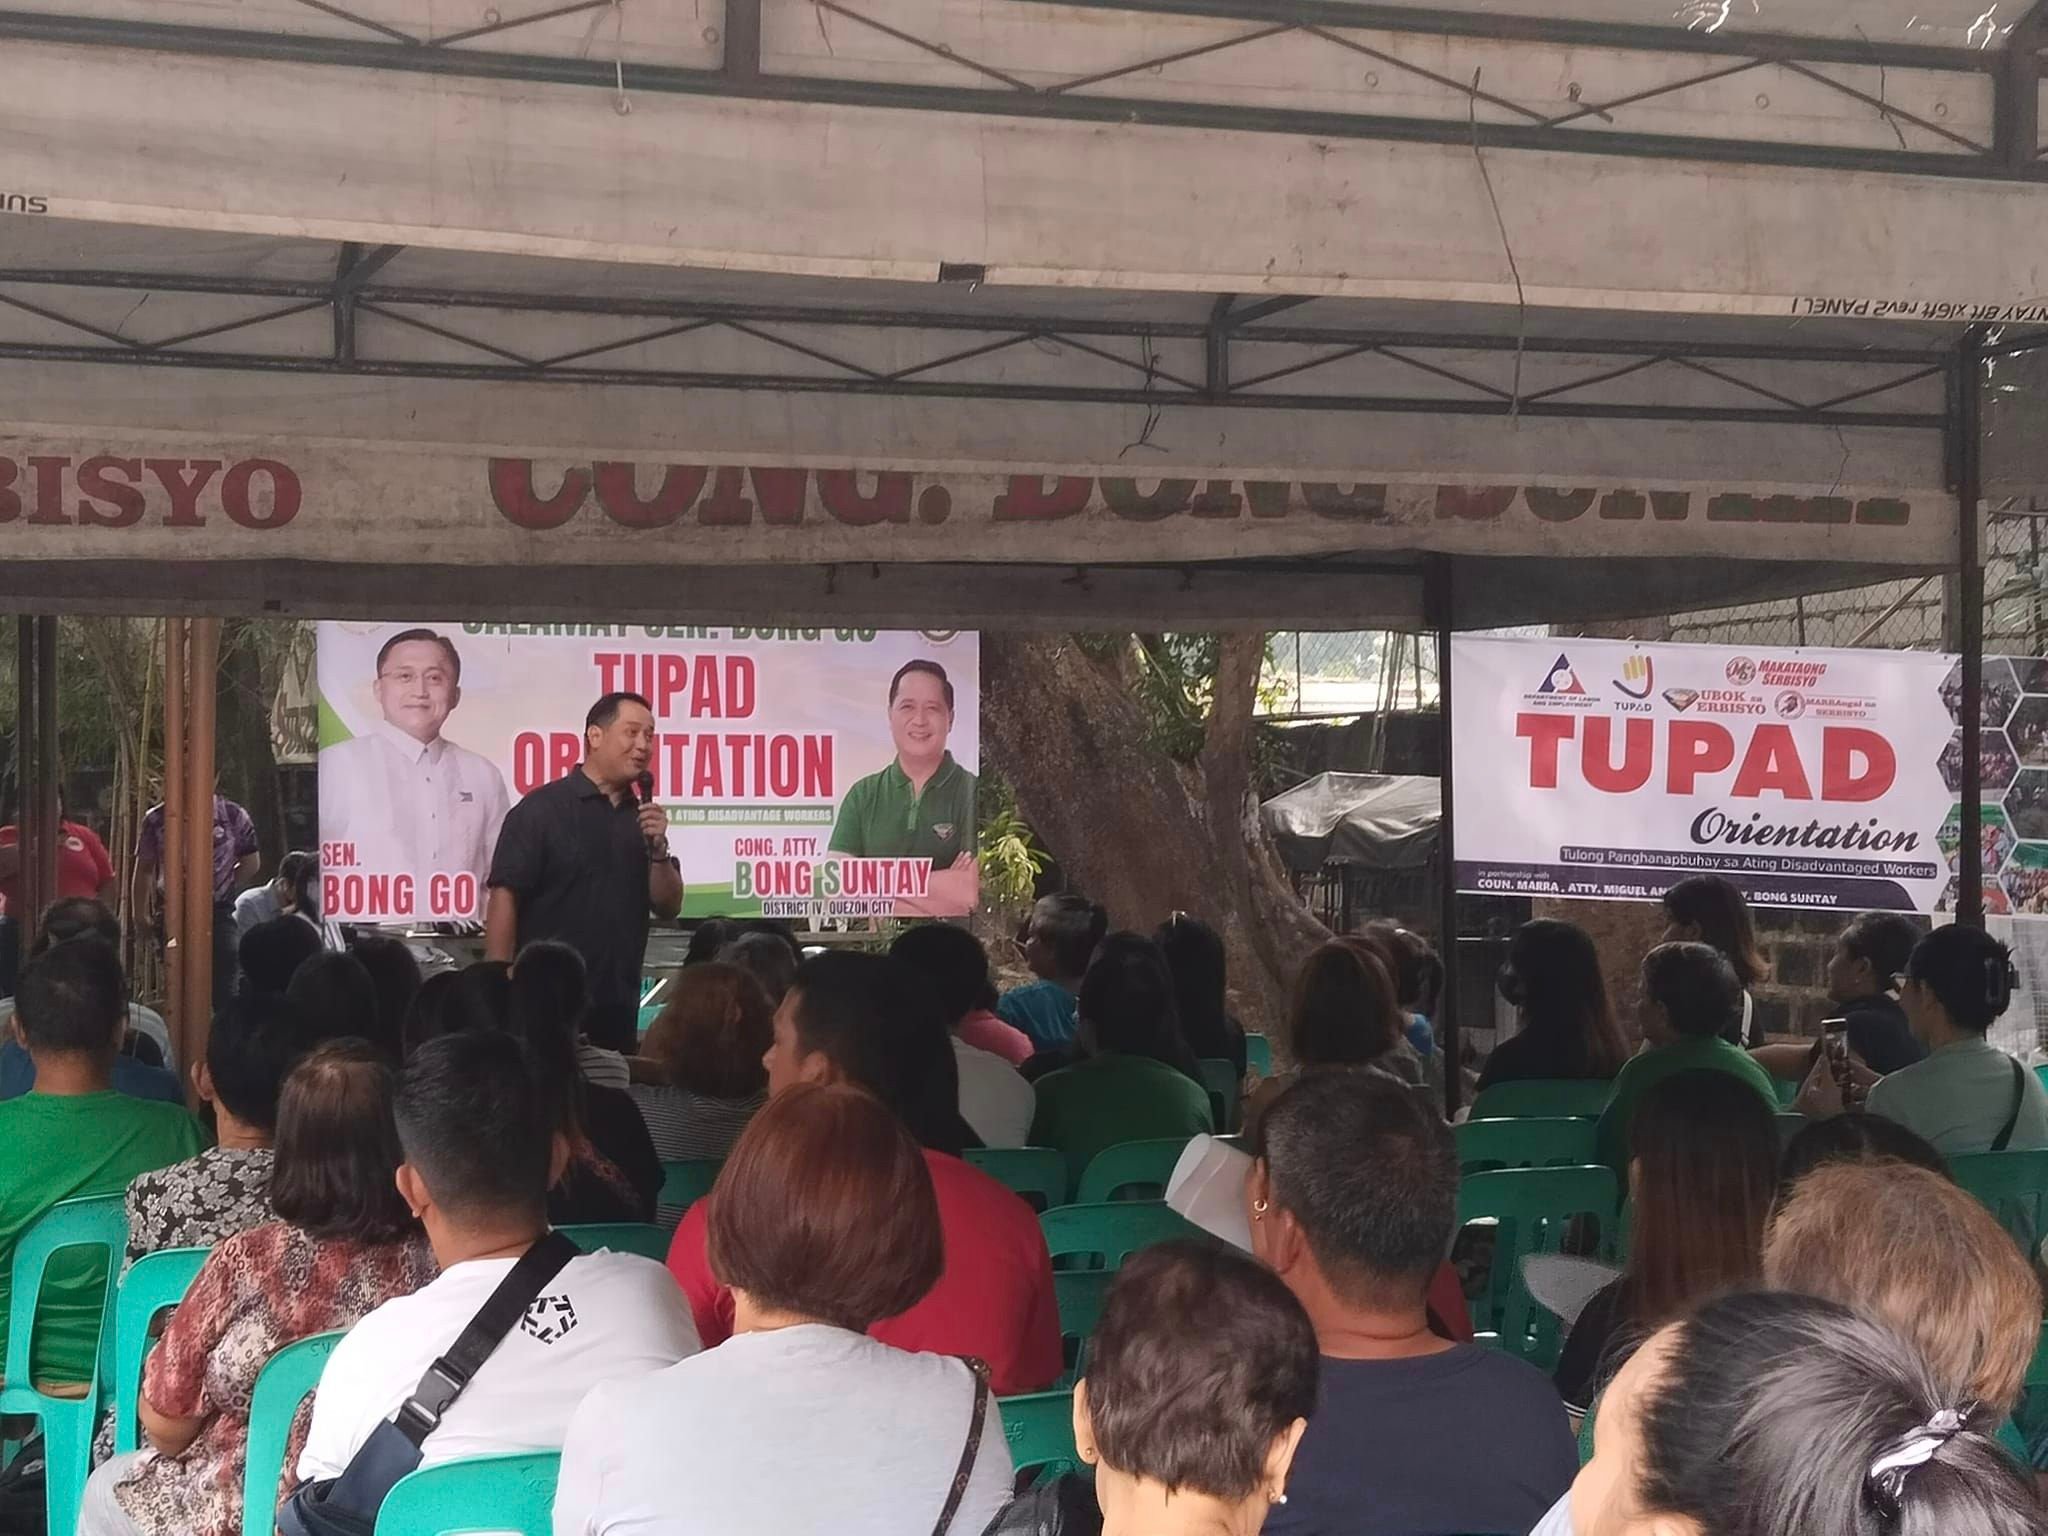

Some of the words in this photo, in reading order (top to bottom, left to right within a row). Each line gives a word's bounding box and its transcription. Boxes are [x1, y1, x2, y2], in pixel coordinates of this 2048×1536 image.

[1804, 298, 1869, 317] PANEL
[1873, 300, 1919, 317] rev2
[1758, 660, 1827, 676] MAKATAONG
[594, 653, 756, 718] TUPAD
[1761, 673, 1818, 688] SERBISYO
[1614, 702, 1653, 712] TUPAD
[513, 731, 834, 798] ORTATION
[1516, 713, 1897, 802] TUPAD
[1690, 806, 1920, 853] Orientation
[322, 843, 362, 867] SEN.
[735, 838, 778, 857] CONG.
[783, 838, 822, 857] ATTY.
[1563, 848, 1604, 863] Tulong
[1608, 850, 1720, 868] Panghanapbuhay
[1723, 858, 1738, 868] sa
[1742, 858, 1777, 872] Ating
[1781, 859, 1880, 876] Disadvantaged
[1883, 863, 1936, 877] Workers
[736, 861, 811, 896] BONG
[823, 859, 931, 896] SUNTAY
[323, 874, 415, 916] BONG
[430, 874, 475, 917] GO
[1478, 879, 1515, 890] COUN.
[1568, 883, 1601, 894] ATTY.
[1603, 885, 1647, 896] MIGUEL
[1650, 887, 1669, 897] AN
[763, 901, 809, 915] DISTRICT
[829, 902, 868, 915] QUEZON
[872, 902, 894, 915] CITY
[1753, 892, 1787, 903] BONG
[1790, 894, 1838, 905] SUNTAY
